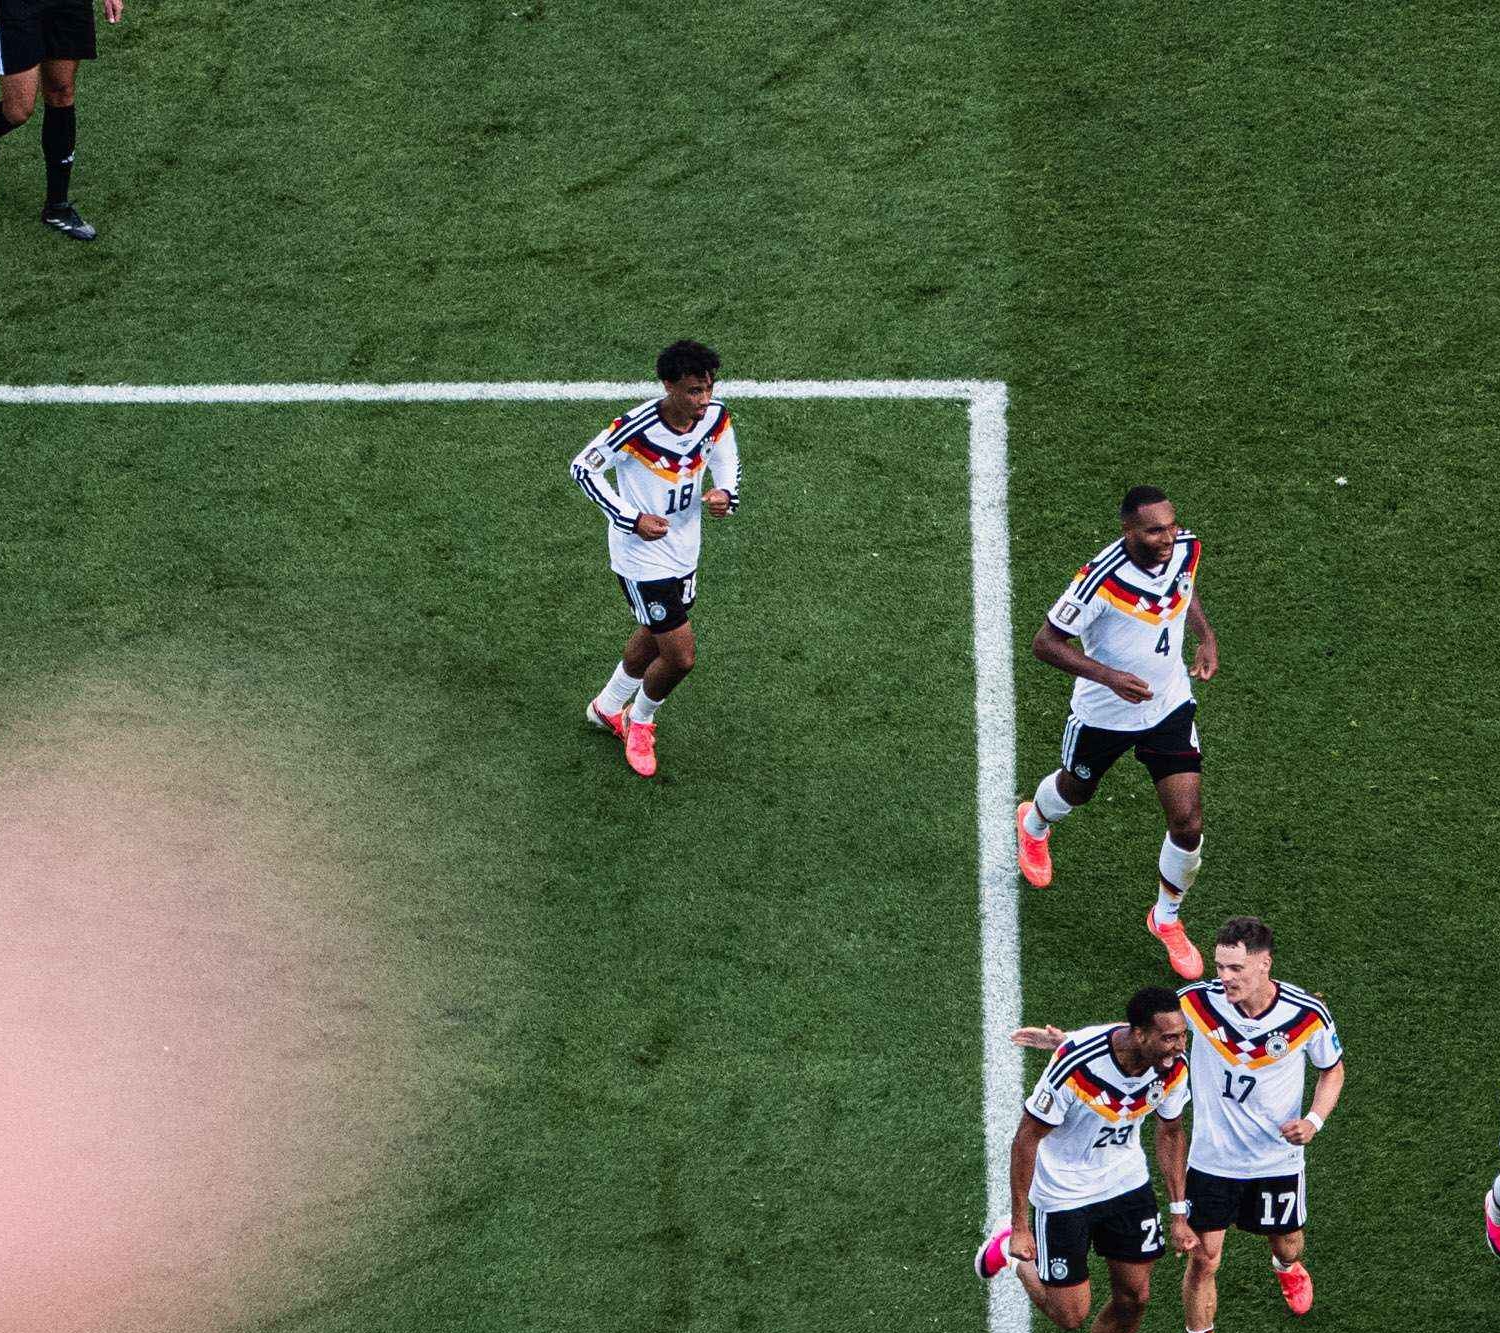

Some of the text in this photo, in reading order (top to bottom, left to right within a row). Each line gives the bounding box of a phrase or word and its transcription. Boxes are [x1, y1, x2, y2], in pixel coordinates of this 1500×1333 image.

[665, 482, 694, 516] 18
[1155, 627, 1170, 657] 4
[1222, 1069, 1257, 1104] 17
[1092, 1124, 1134, 1149] 23
[1260, 1191, 1297, 1226] 17
